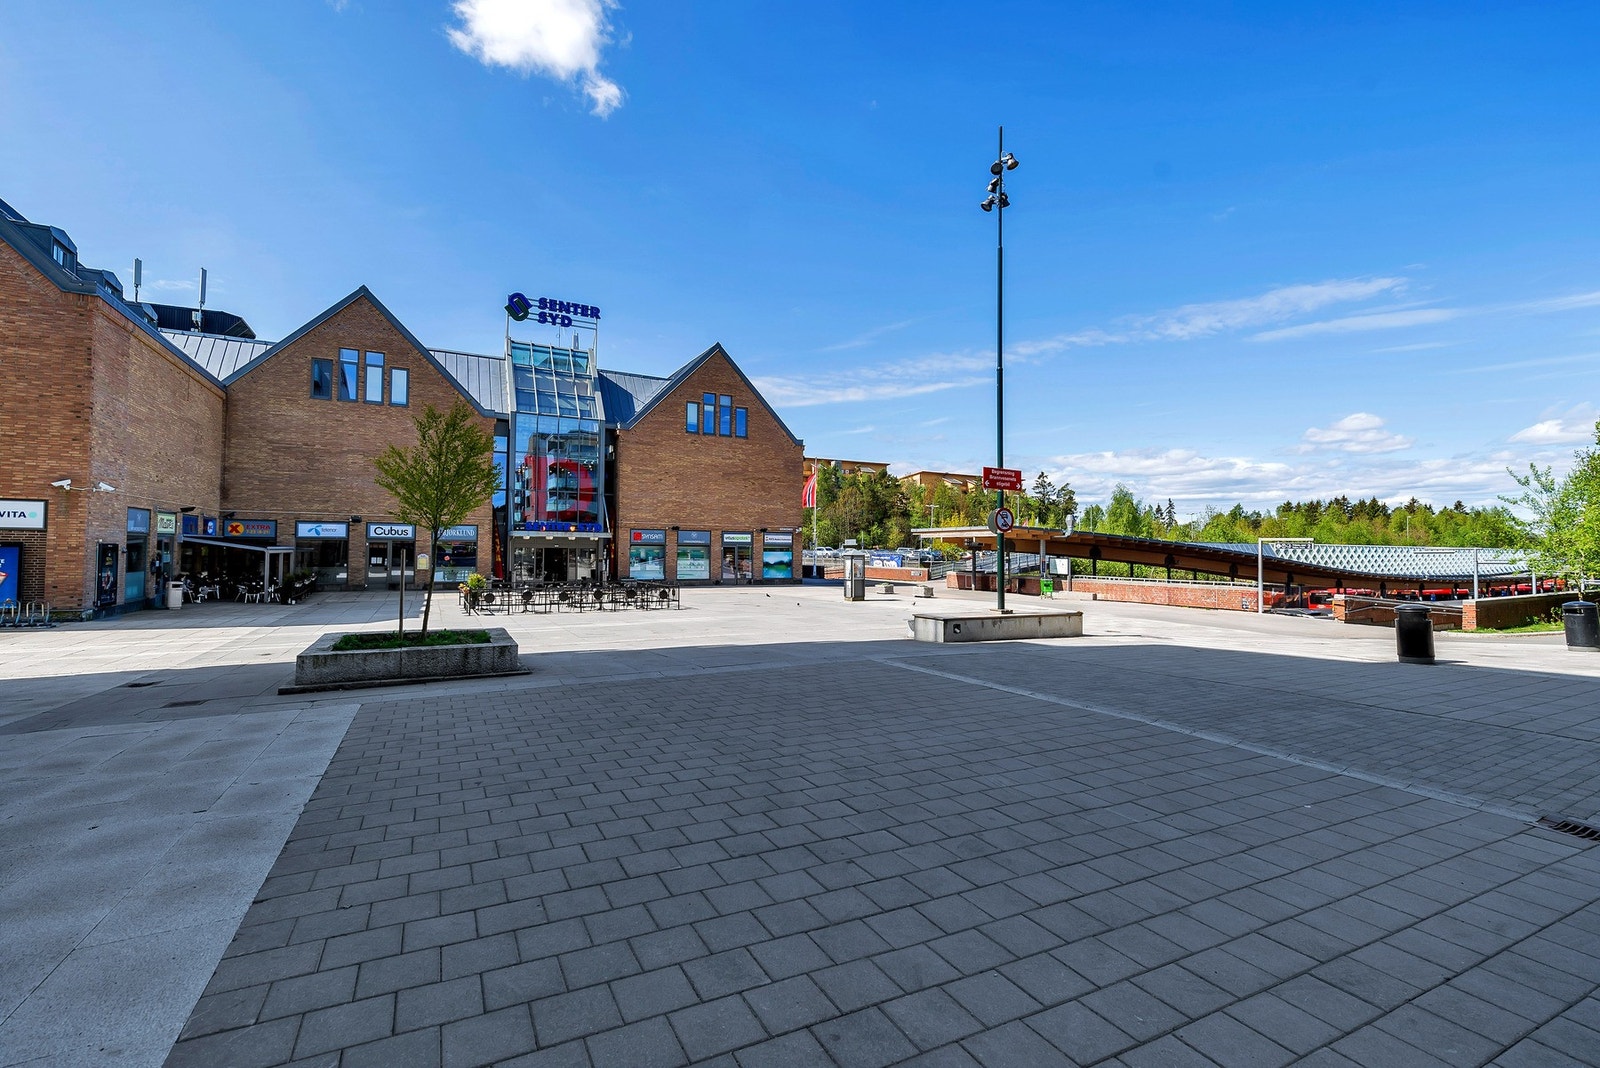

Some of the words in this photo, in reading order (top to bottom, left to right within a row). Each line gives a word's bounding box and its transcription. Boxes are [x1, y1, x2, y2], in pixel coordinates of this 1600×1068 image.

[538, 297, 601, 319] SENTER
[538, 311, 572, 327] SYD
[374, 526, 408, 536] Cubus
